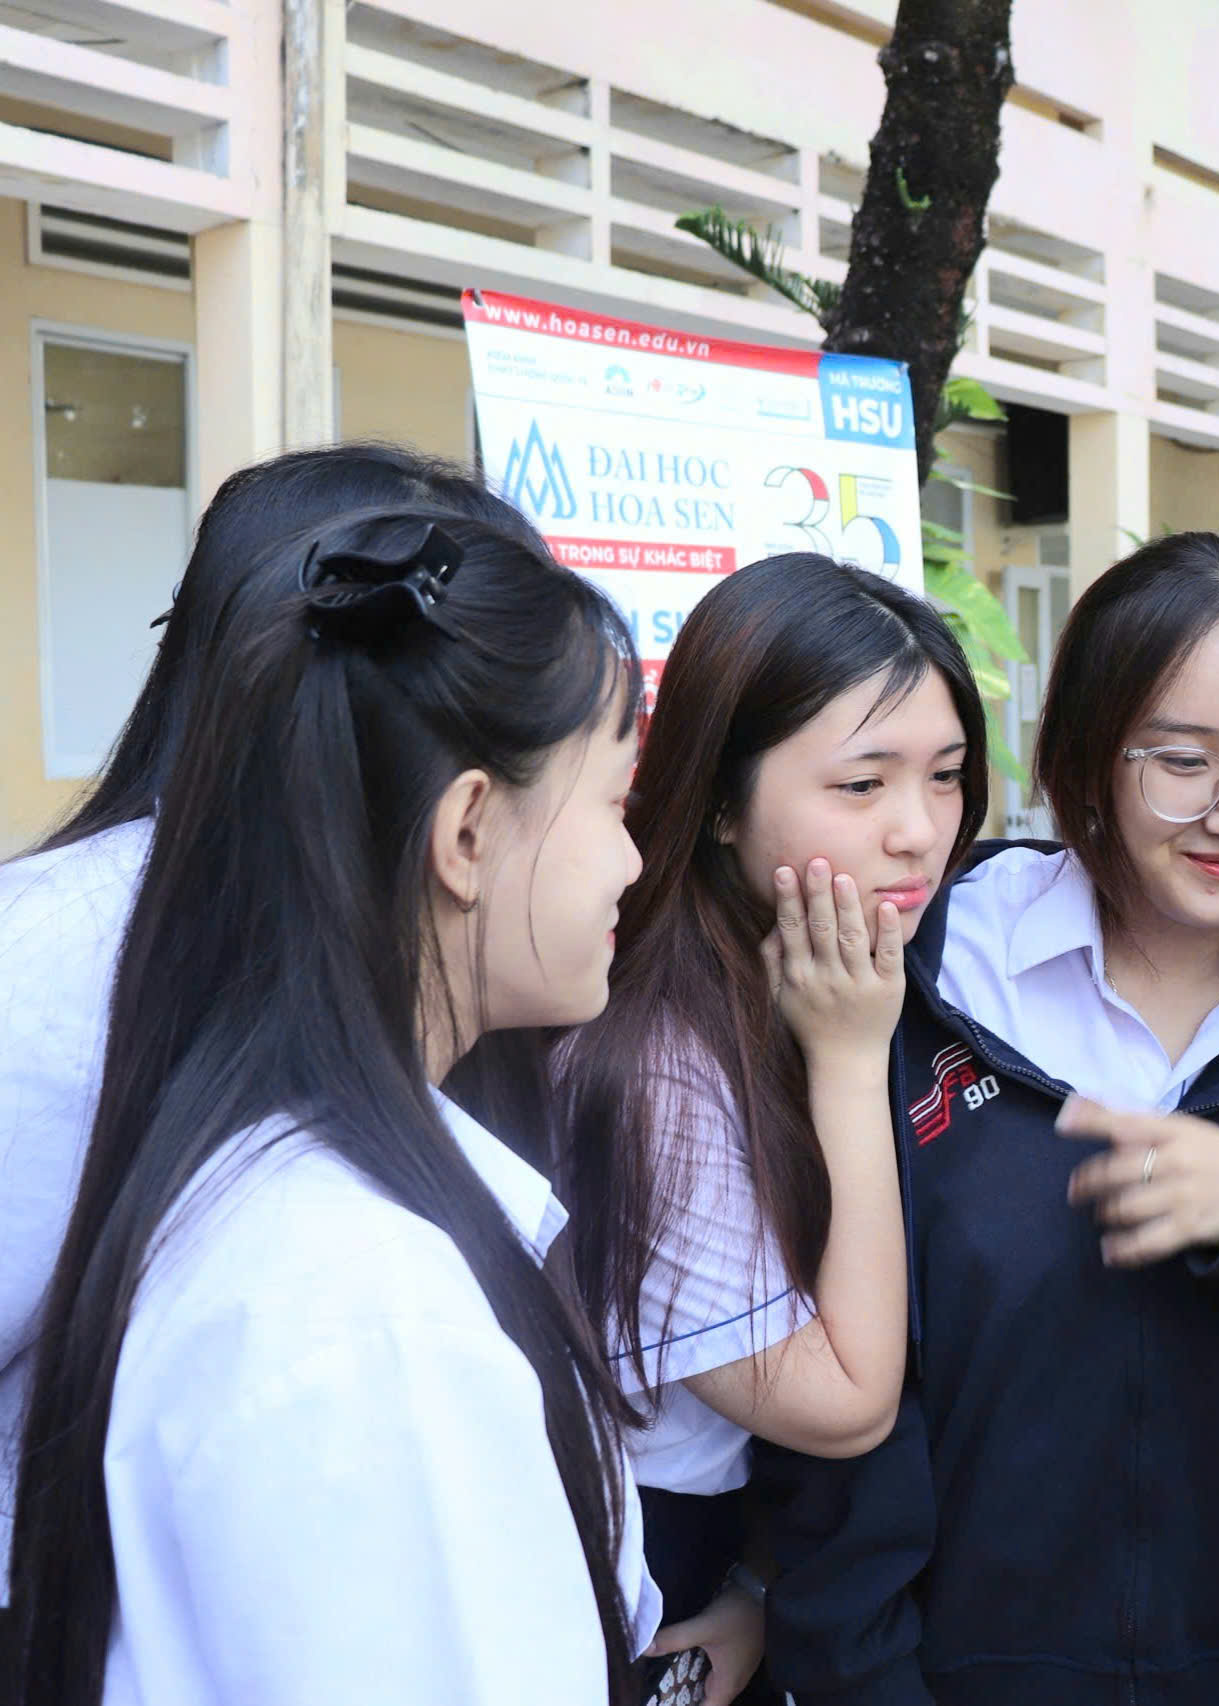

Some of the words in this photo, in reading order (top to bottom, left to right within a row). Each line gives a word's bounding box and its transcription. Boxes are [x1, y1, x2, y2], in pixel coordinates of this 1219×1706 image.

[484, 304, 710, 357] www.hoasen.edu.vn
[831, 394, 903, 438] HSU
[589, 491, 666, 528] HOA
[674, 498, 735, 531] SEN
[559, 544, 615, 566] TRỌNG
[618, 548, 641, 568] SỰ
[644, 547, 686, 568] KHÁC
[690, 550, 723, 571] BIỆT
[962, 1074, 1000, 1111] 90
